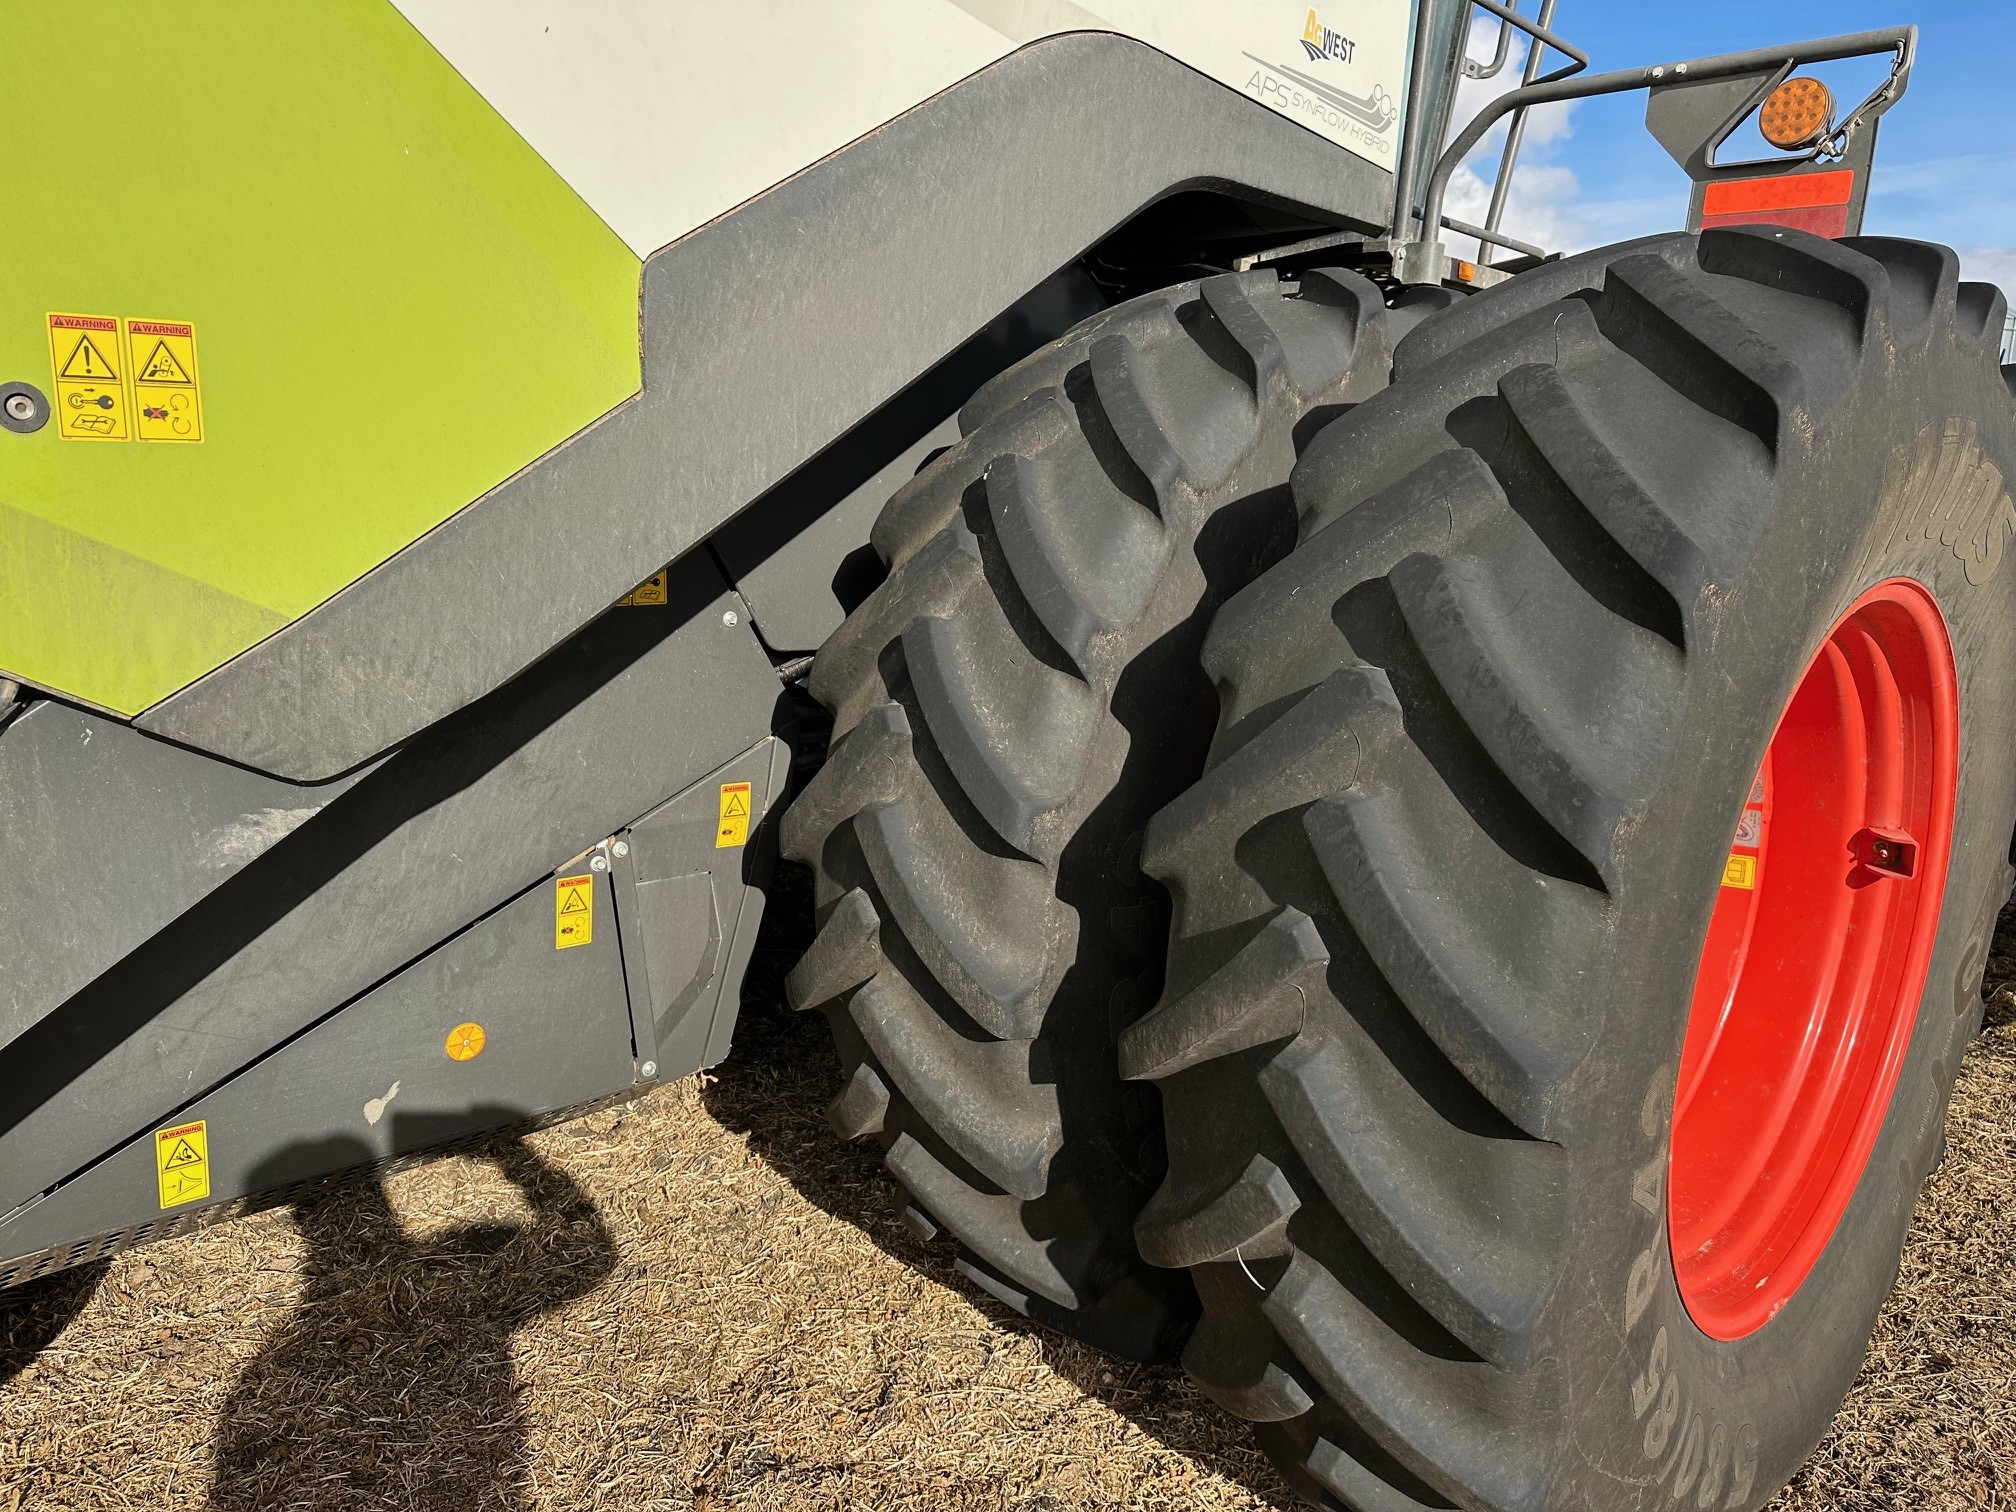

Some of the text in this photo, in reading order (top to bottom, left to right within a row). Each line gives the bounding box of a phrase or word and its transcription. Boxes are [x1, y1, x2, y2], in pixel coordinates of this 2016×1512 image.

[1245, 71, 1390, 154] APS SYNFLOW HYBRID
[63, 318, 115, 330] WARNING
[142, 324, 190, 335] WARNING
[169, 1124, 202, 1138] WARNING
